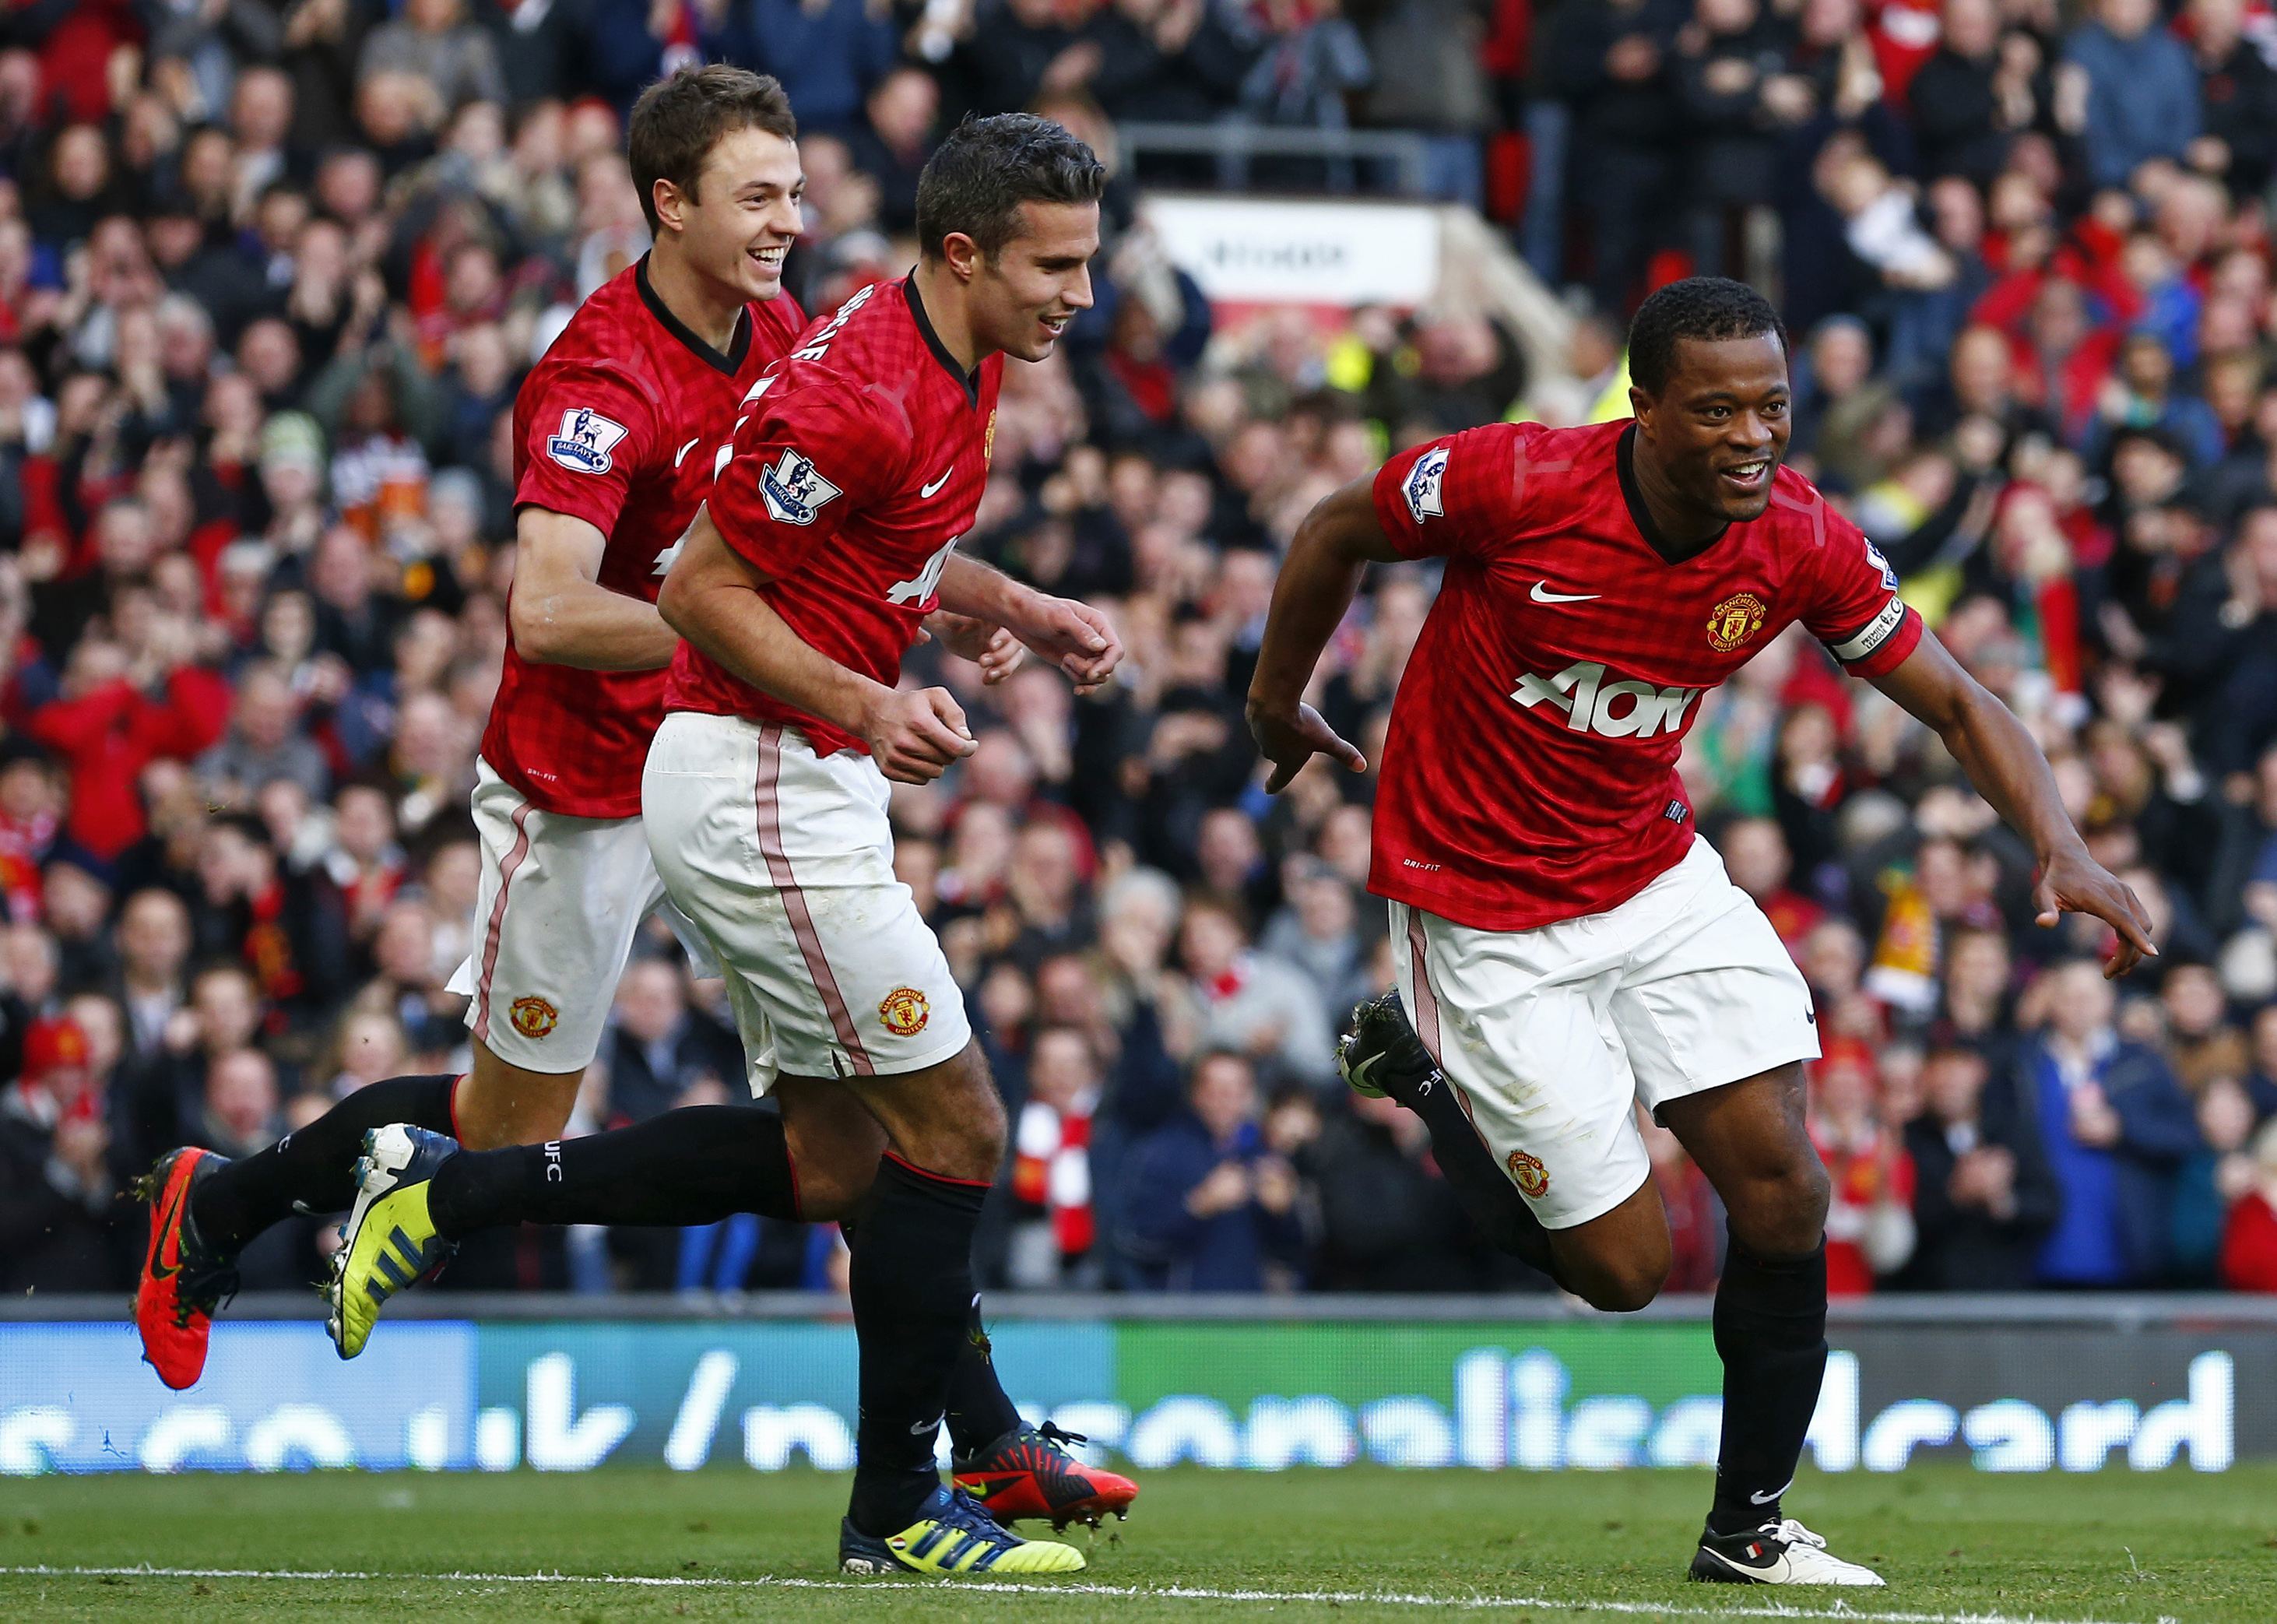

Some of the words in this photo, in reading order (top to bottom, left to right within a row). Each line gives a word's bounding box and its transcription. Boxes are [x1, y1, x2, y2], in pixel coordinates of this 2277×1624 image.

[769, 480, 799, 510] BARCLAYS
[1717, 598, 1760, 617] MANCHESTER
[1713, 638, 1744, 649] UNITED
[1403, 858, 1441, 872] DRI-FIT
[882, 990, 923, 1012] MANCHESTER
[895, 1021, 924, 1034] UNITED
